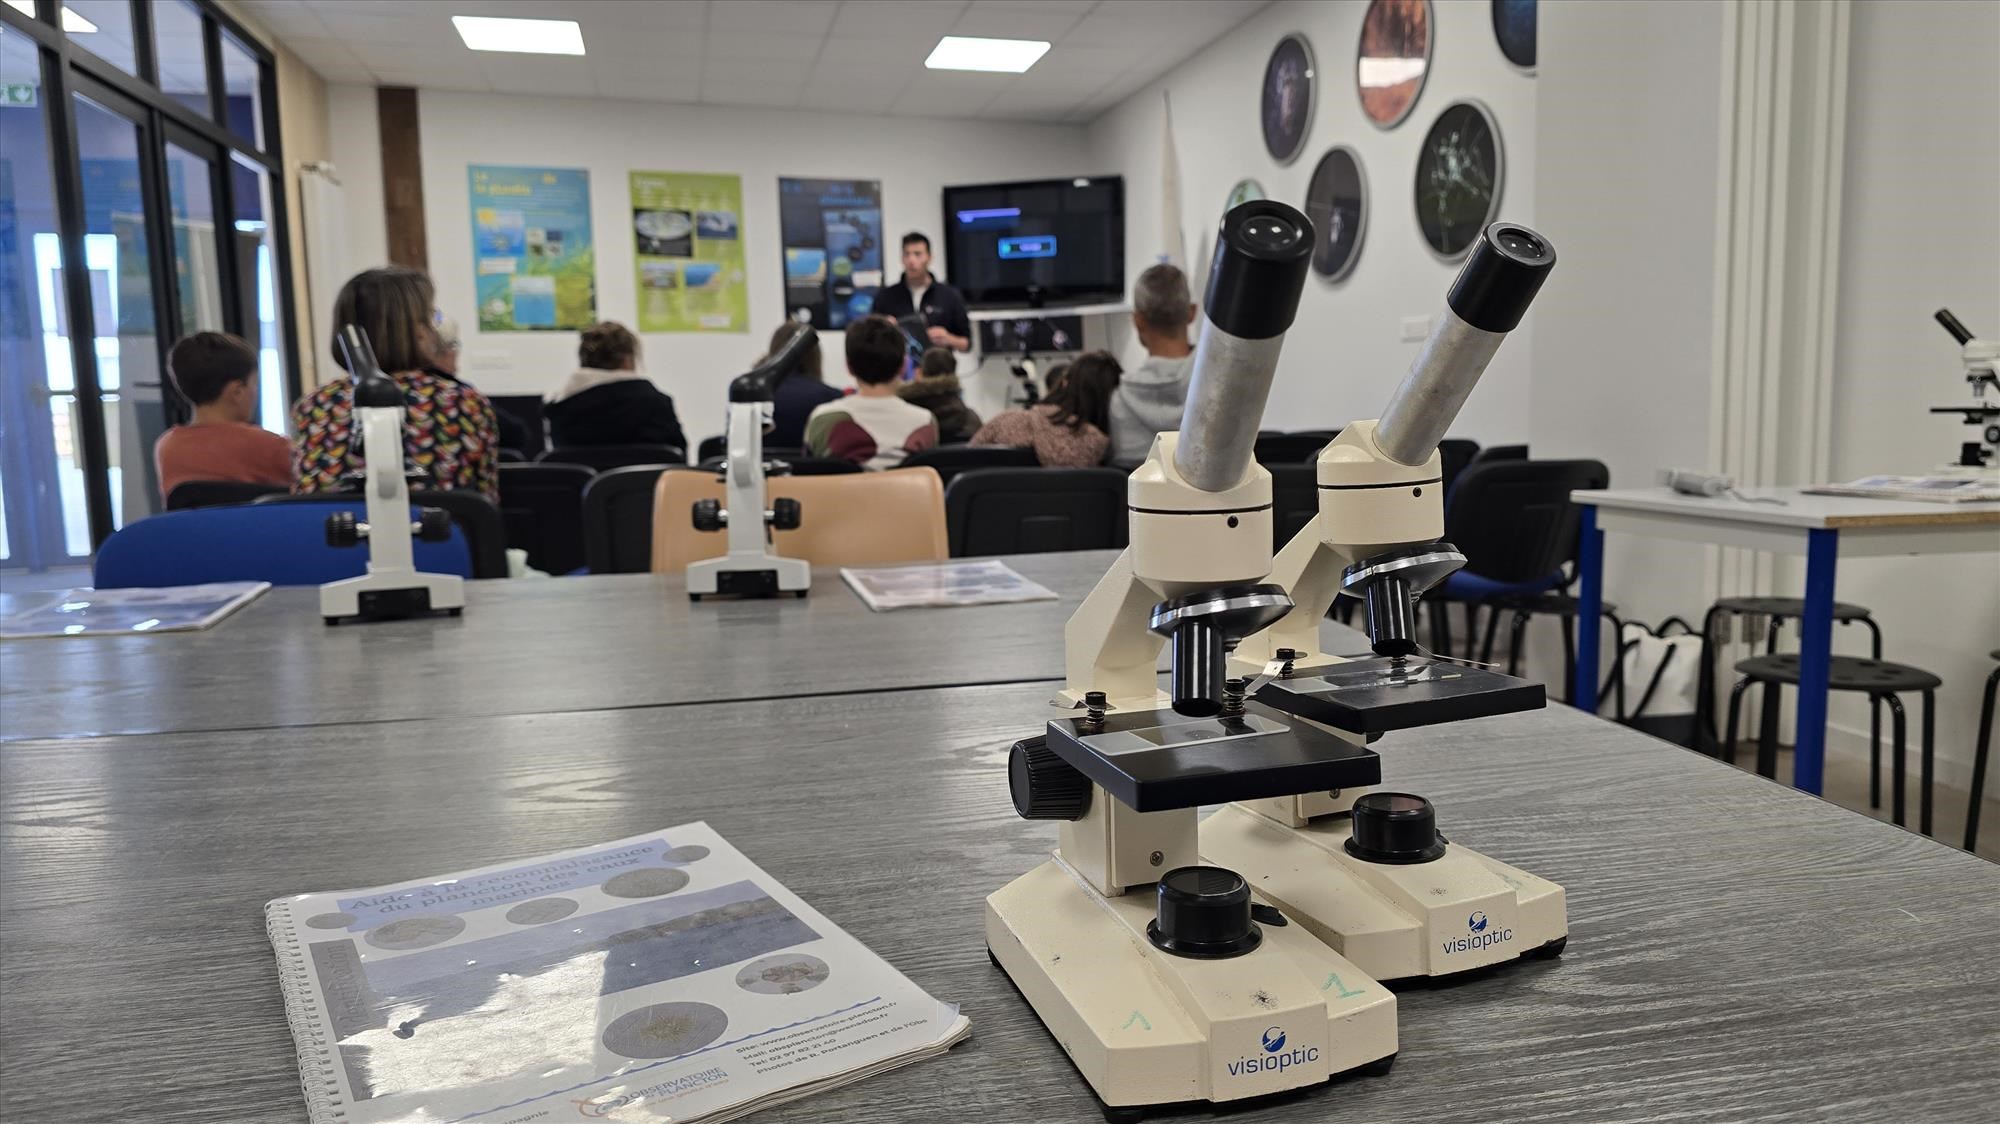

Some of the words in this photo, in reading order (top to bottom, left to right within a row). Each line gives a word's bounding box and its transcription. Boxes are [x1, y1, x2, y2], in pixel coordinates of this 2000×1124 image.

[351, 893, 406, 910] Aide
[446, 883, 468, 893] la
[477, 846, 654, 887] reconnaissance
[379, 901, 411, 914] du
[422, 878, 529, 908] plancton
[539, 869, 579, 883] des
[586, 857, 640, 873] eaux
[471, 880, 571, 906] marines
[1442, 926, 1513, 954] visioptic
[756, 1061, 794, 1074] Photos
[1227, 1044, 1319, 1076] visioptic
[630, 1066, 722, 1099] OBSERVATOIRE
[659, 1070, 729, 1097] PLANCTON
[503, 1110, 549, 1124] pagnie
